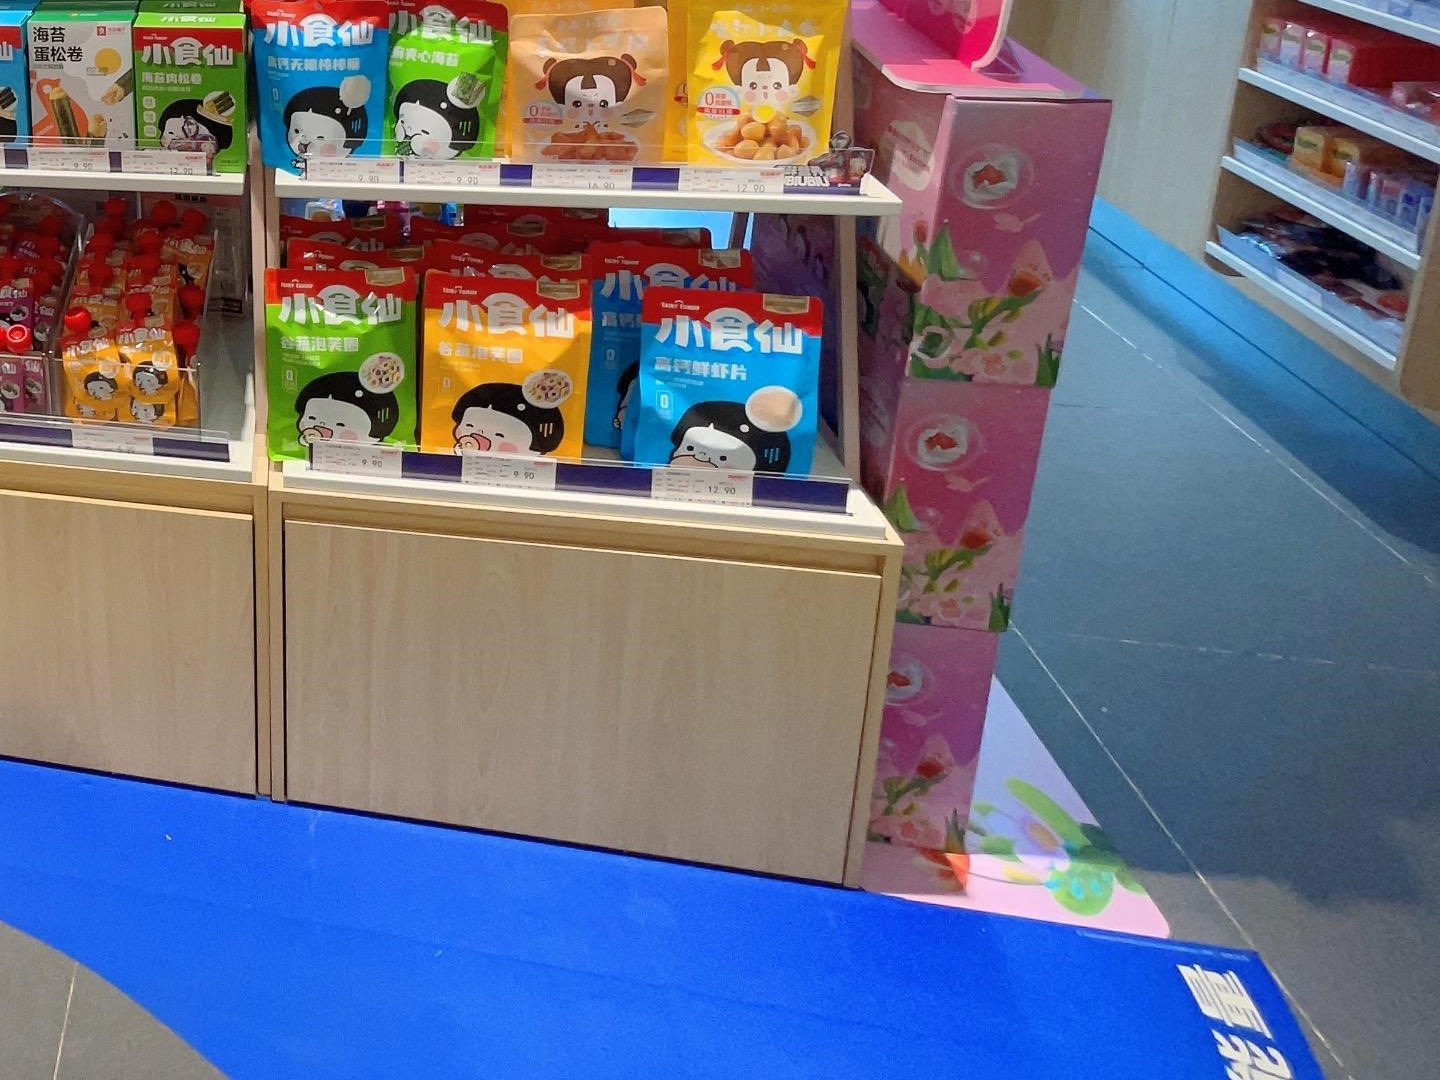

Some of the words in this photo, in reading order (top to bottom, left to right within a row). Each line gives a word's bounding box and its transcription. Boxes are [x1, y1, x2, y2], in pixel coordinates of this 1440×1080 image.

[33, 27, 65, 42] 海苔
[264, 13, 374, 46] 小食仙
[389, 5, 493, 45] 小食仙
[34, 46, 83, 62] 蛋松卷
[141, 37, 233, 66] 小食仙
[142, 72, 202, 84] 海苔肉松卷
[278, 285, 401, 325] 小食仙
[438, 293, 574, 339] 小食仙
[655, 307, 803, 354] 小食仙
[655, 357, 747, 381] 高钙鲜虾片
